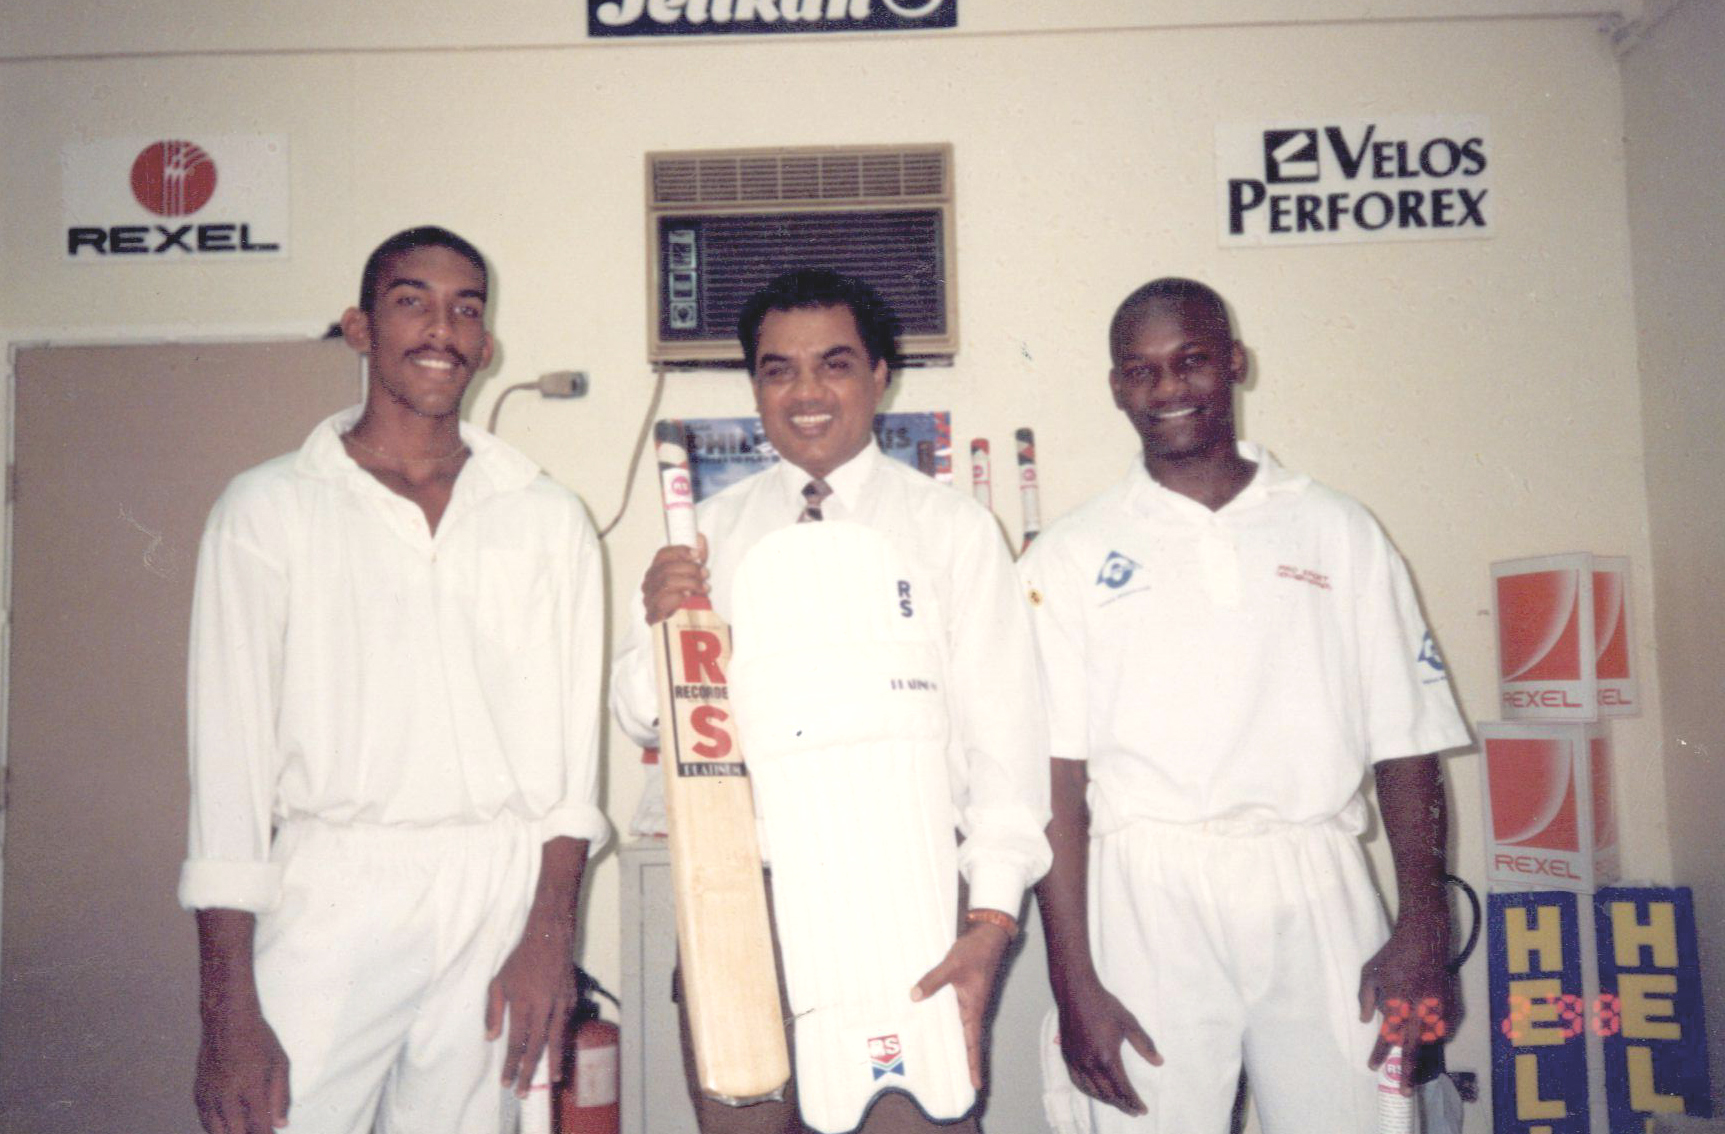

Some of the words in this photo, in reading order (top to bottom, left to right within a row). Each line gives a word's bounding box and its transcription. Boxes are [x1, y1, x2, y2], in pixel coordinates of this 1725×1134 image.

[1324, 124, 1488, 180] VELOS
[1228, 178, 1488, 235] PERFOREX
[68, 223, 280, 255] REXEL
[680, 630, 727, 684] R
[1502, 690, 1583, 708] REXEL
[1597, 688, 1632, 706] EL
[690, 705, 732, 758] S
[1494, 853, 1581, 880] REXEL
[1504, 905, 1567, 1134] HEL
